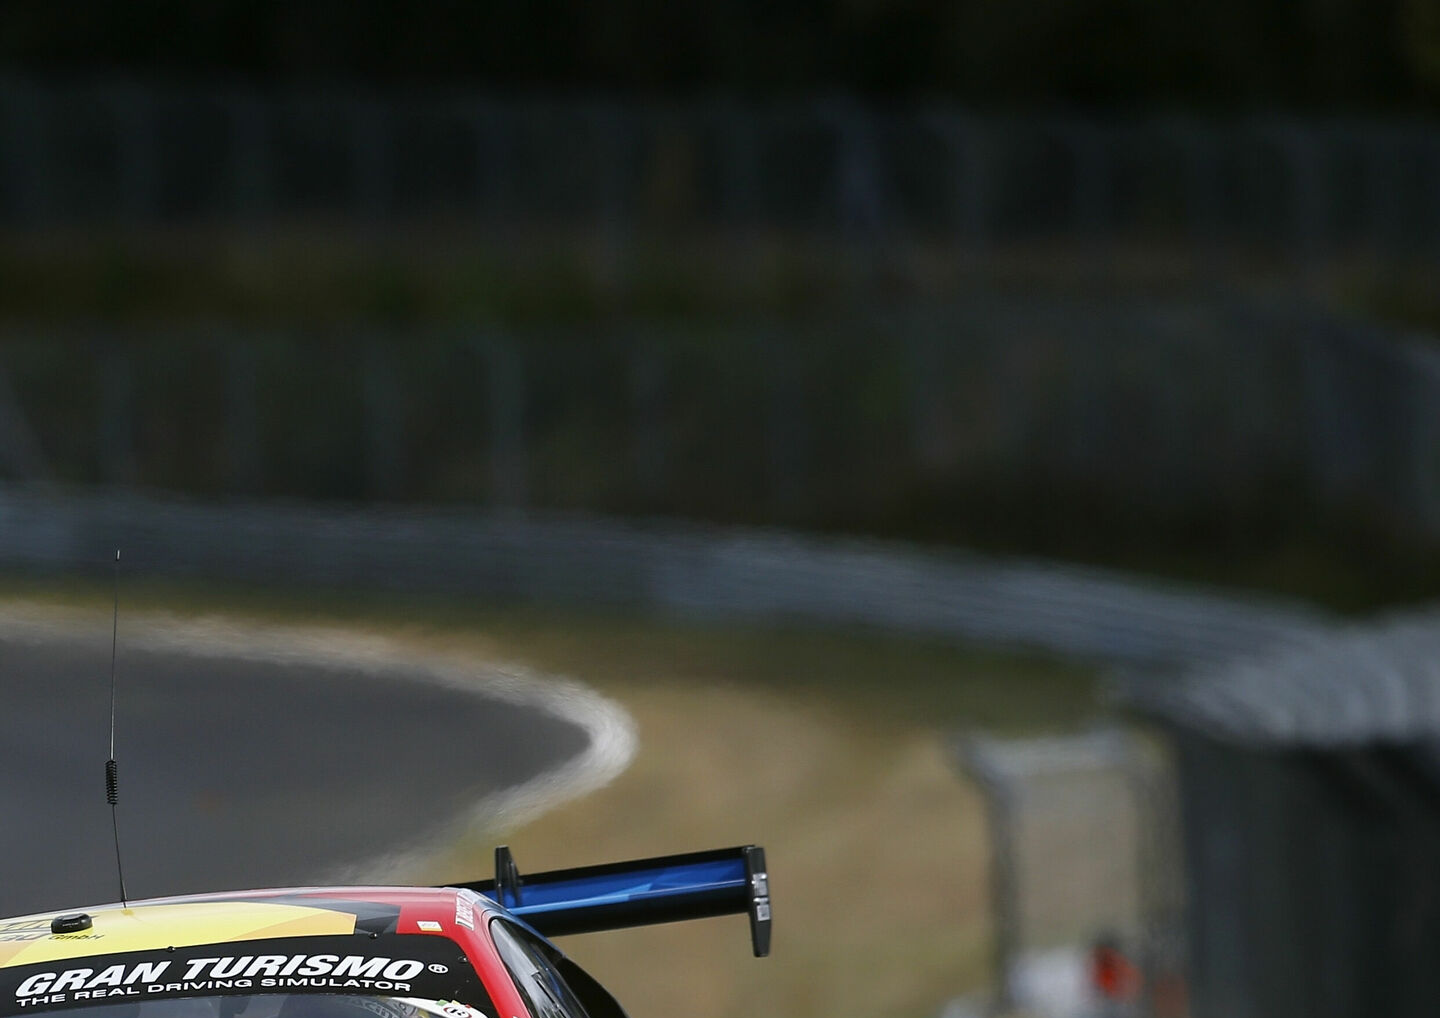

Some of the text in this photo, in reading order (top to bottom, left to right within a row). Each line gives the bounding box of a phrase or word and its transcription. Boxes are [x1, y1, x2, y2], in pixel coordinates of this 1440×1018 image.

[15, 954, 424, 998] GRAN TURISMO
[16, 976, 411, 1008] THE REAL DRIVING SIMULATOR
